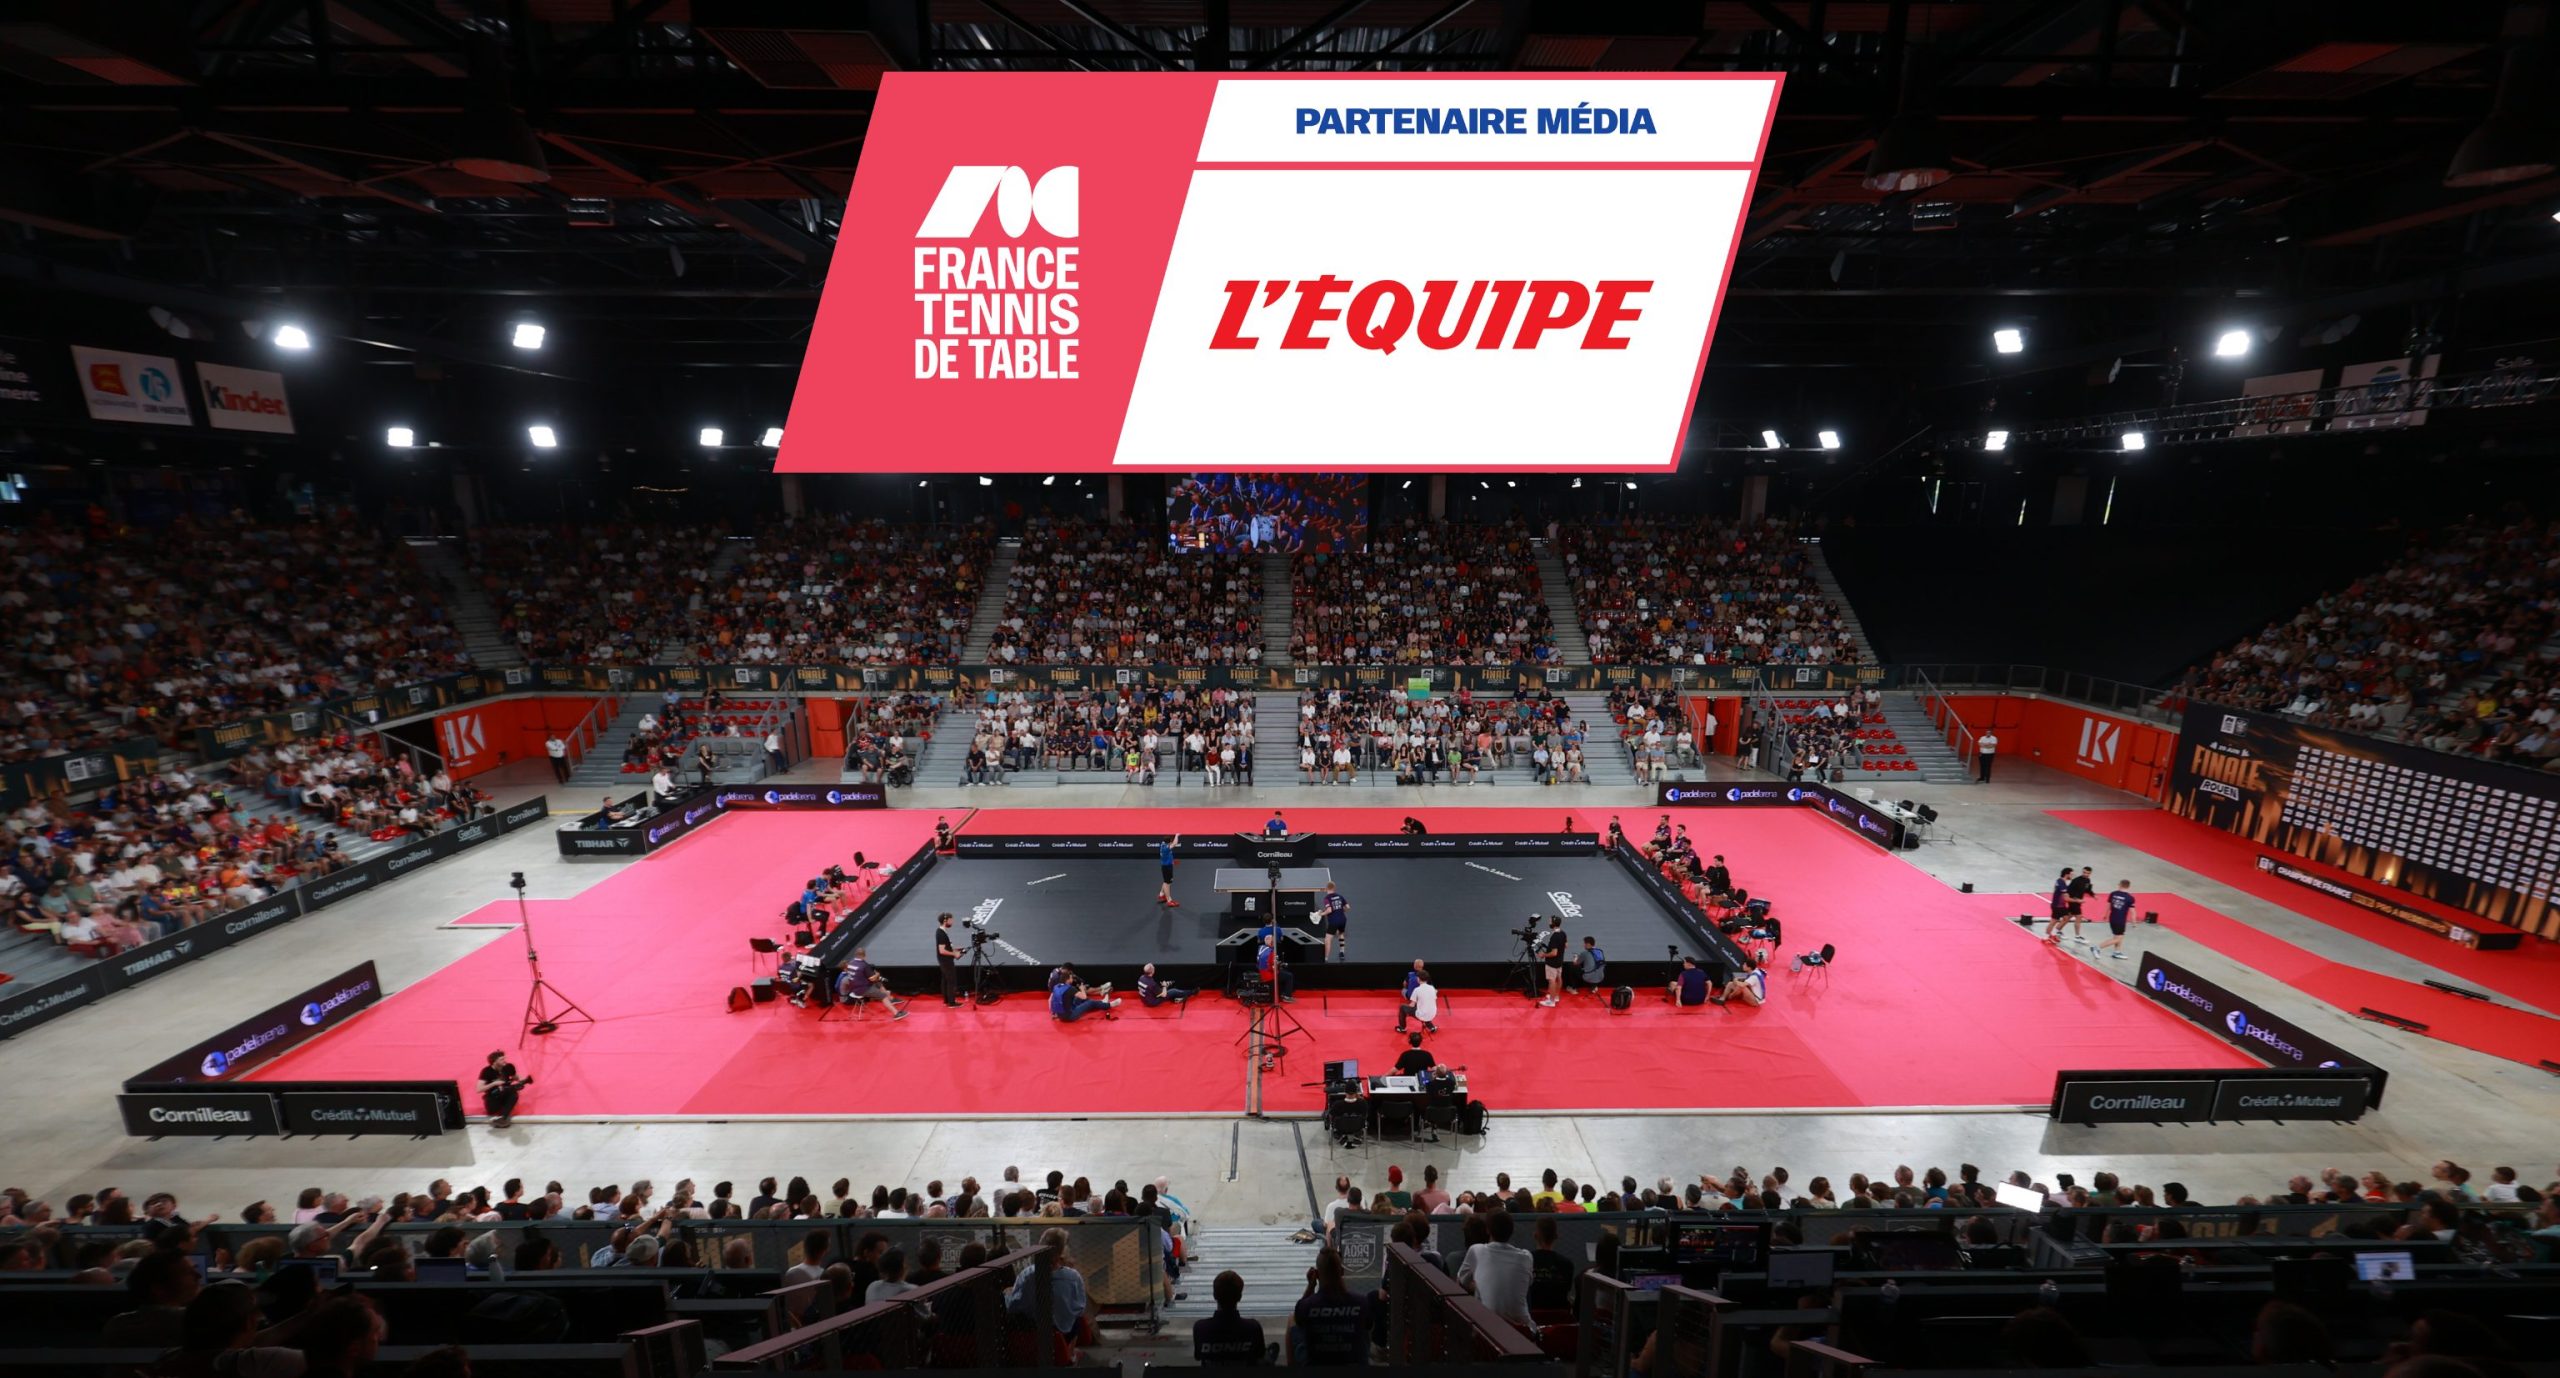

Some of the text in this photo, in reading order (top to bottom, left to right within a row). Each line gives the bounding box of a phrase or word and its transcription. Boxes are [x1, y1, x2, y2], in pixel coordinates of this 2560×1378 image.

[2190, 743, 2266, 791] FINALE
[2202, 781, 2237, 799] ROUEN
[574, 839, 614, 848] TIBHAR
[225, 905, 288, 935] Cornilleau
[122, 948, 176, 976] TIBHAR
[2163, 979, 2213, 1013] padelarena
[2245, 1022, 2303, 1061] padelarena
[2089, 1095, 2186, 1110] Cornilleau
[2239, 1095, 2342, 1108] Crédit Mutuel
[149, 1107, 251, 1123] Cornilleau
[311, 1108, 418, 1121] Crédit Mutuel
[1309, 1306, 1361, 1318] DONIC
[1201, 1342, 1253, 1353] DONIC
